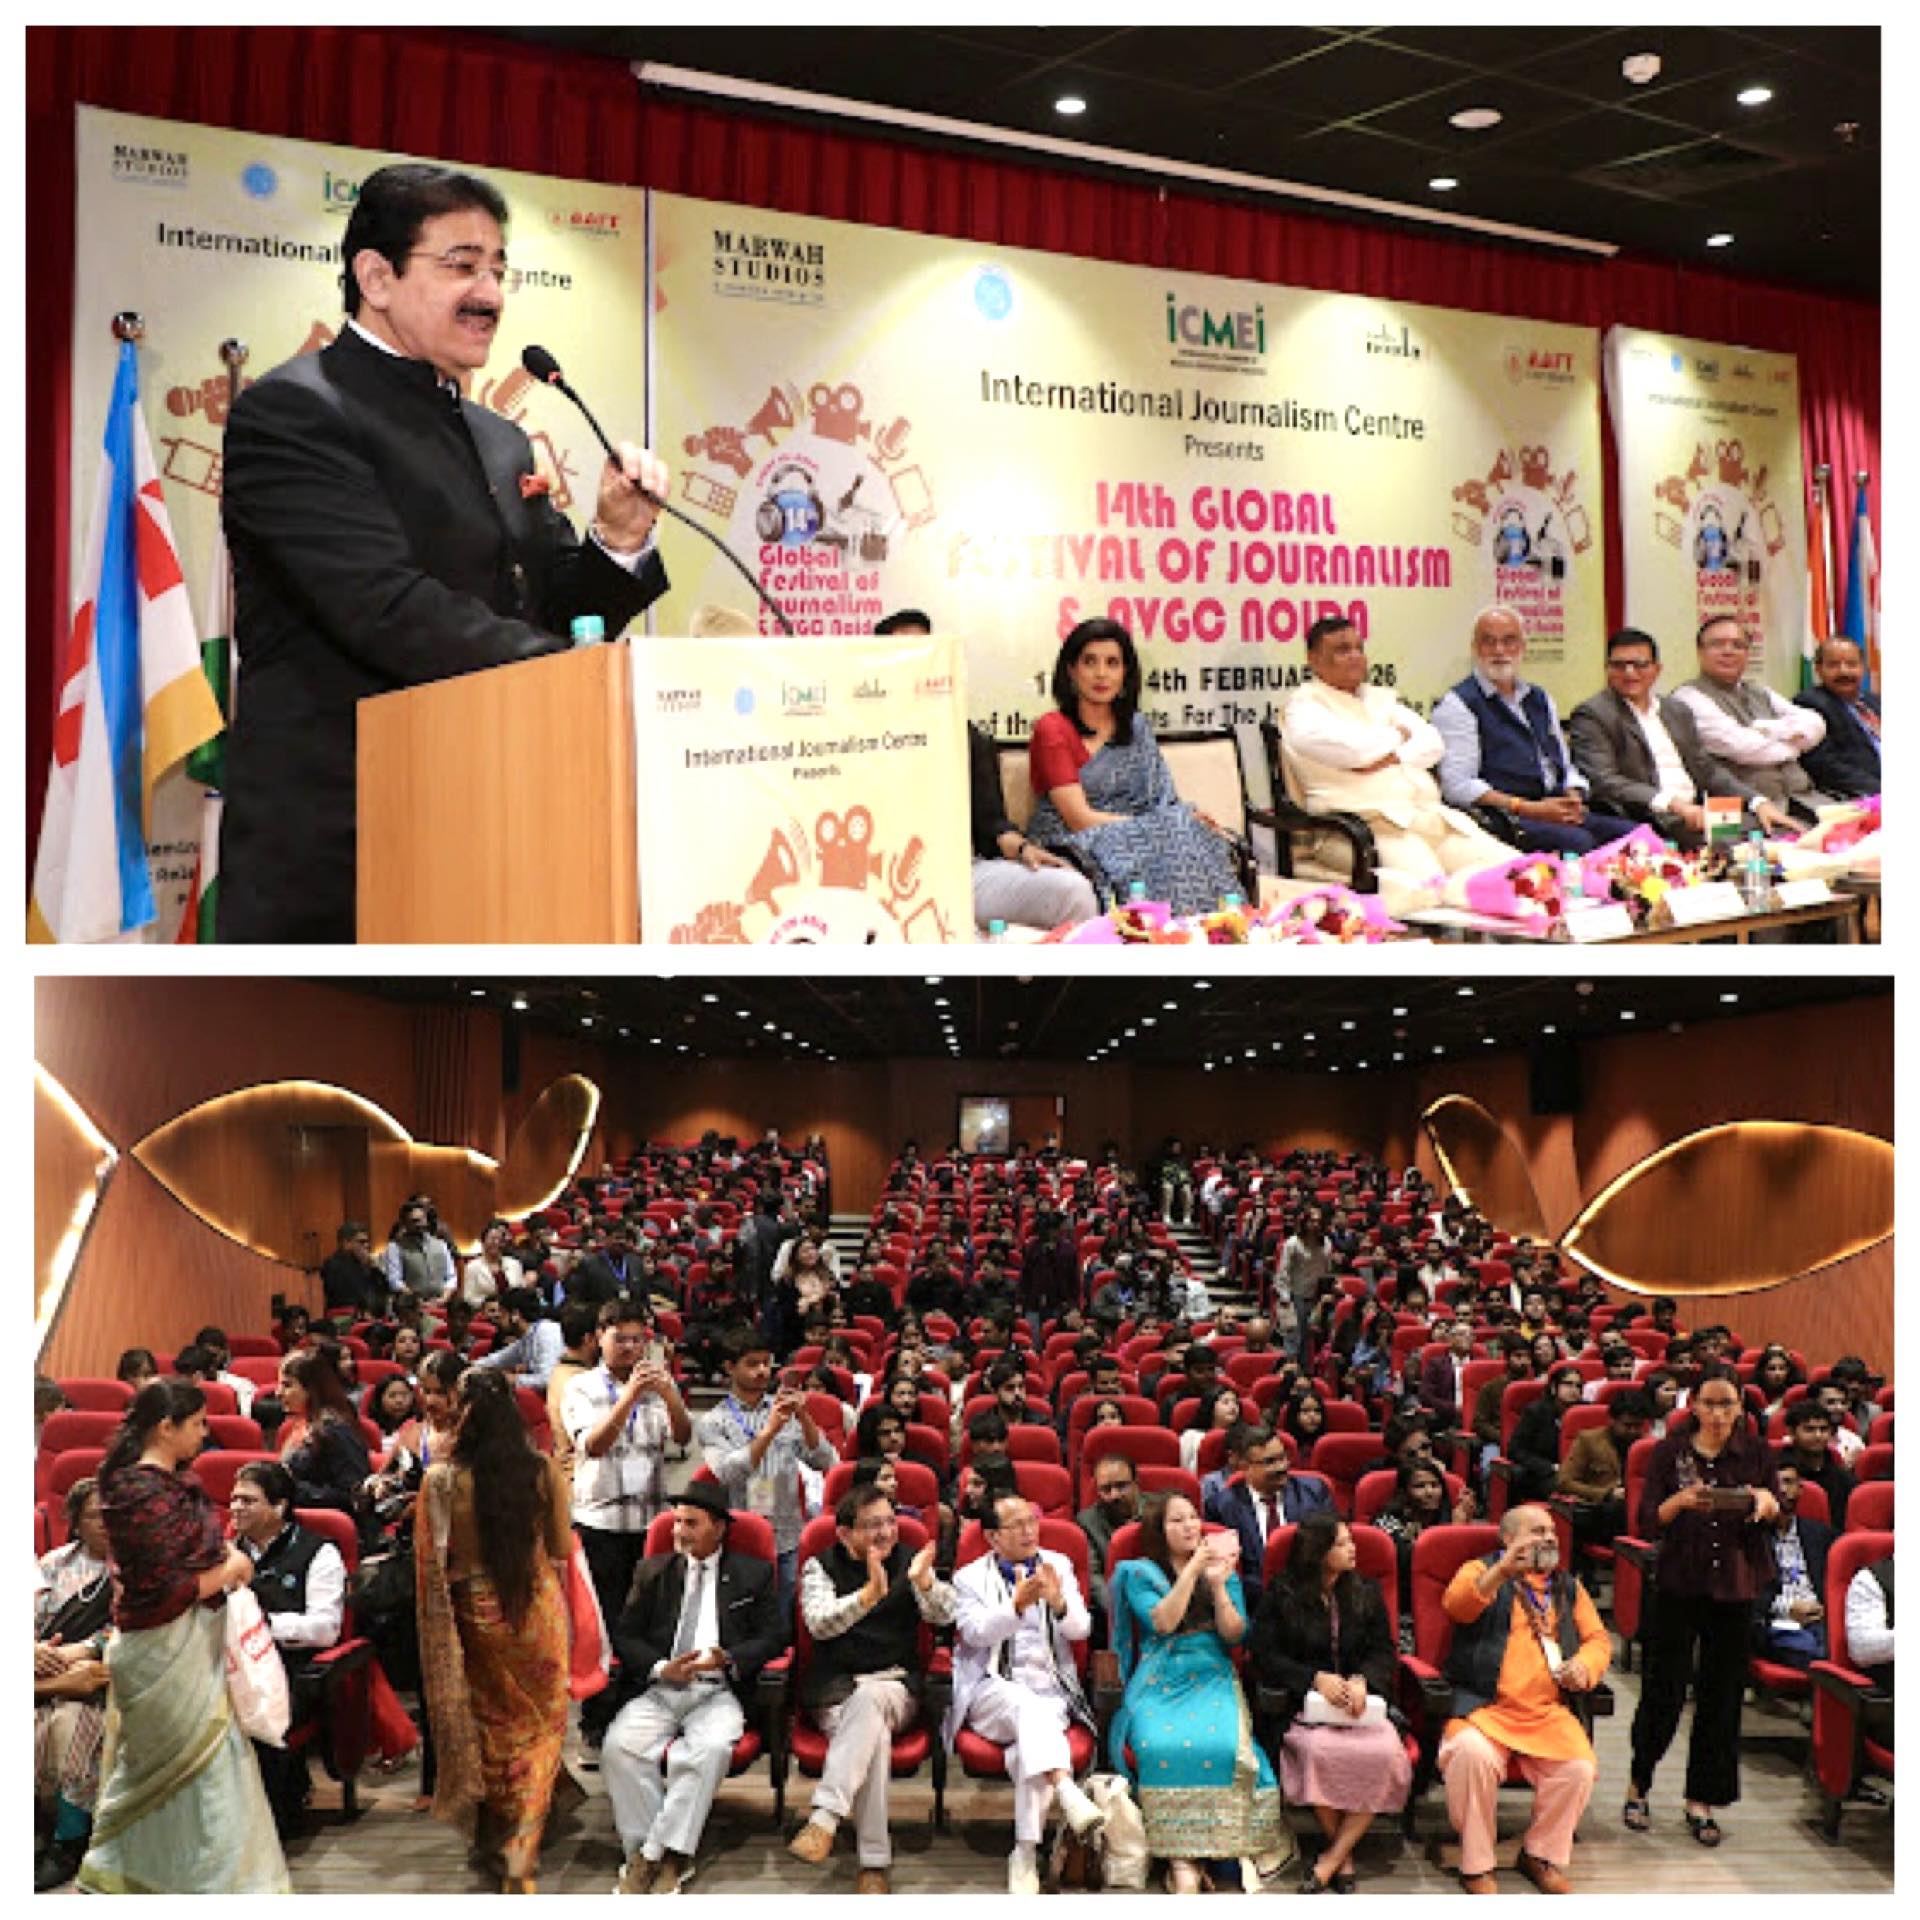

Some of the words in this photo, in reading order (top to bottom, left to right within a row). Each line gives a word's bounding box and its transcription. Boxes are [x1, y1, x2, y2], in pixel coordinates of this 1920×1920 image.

[158, 222, 343, 264] International
[714, 230, 824, 265] MARWAH
[713, 257, 824, 287] STUDIOS
[981, 368, 1182, 420] International
[1190, 390, 1337, 433] Journalism
[1344, 404, 1424, 440] Centre
[1185, 435, 1264, 461] Presents
[1095, 481, 1176, 528] 14th
[1191, 486, 1337, 535] GLOBAL
[759, 545, 839, 569] Global
[1157, 537, 1216, 584] OF
[1227, 540, 1451, 588] JOURNALISM
[760, 567, 849, 591] Festival
[855, 571, 879, 591] of
[1107, 596, 1227, 643] AVGC
[1145, 667, 1187, 692] 4th
[685, 739, 794, 769] International
